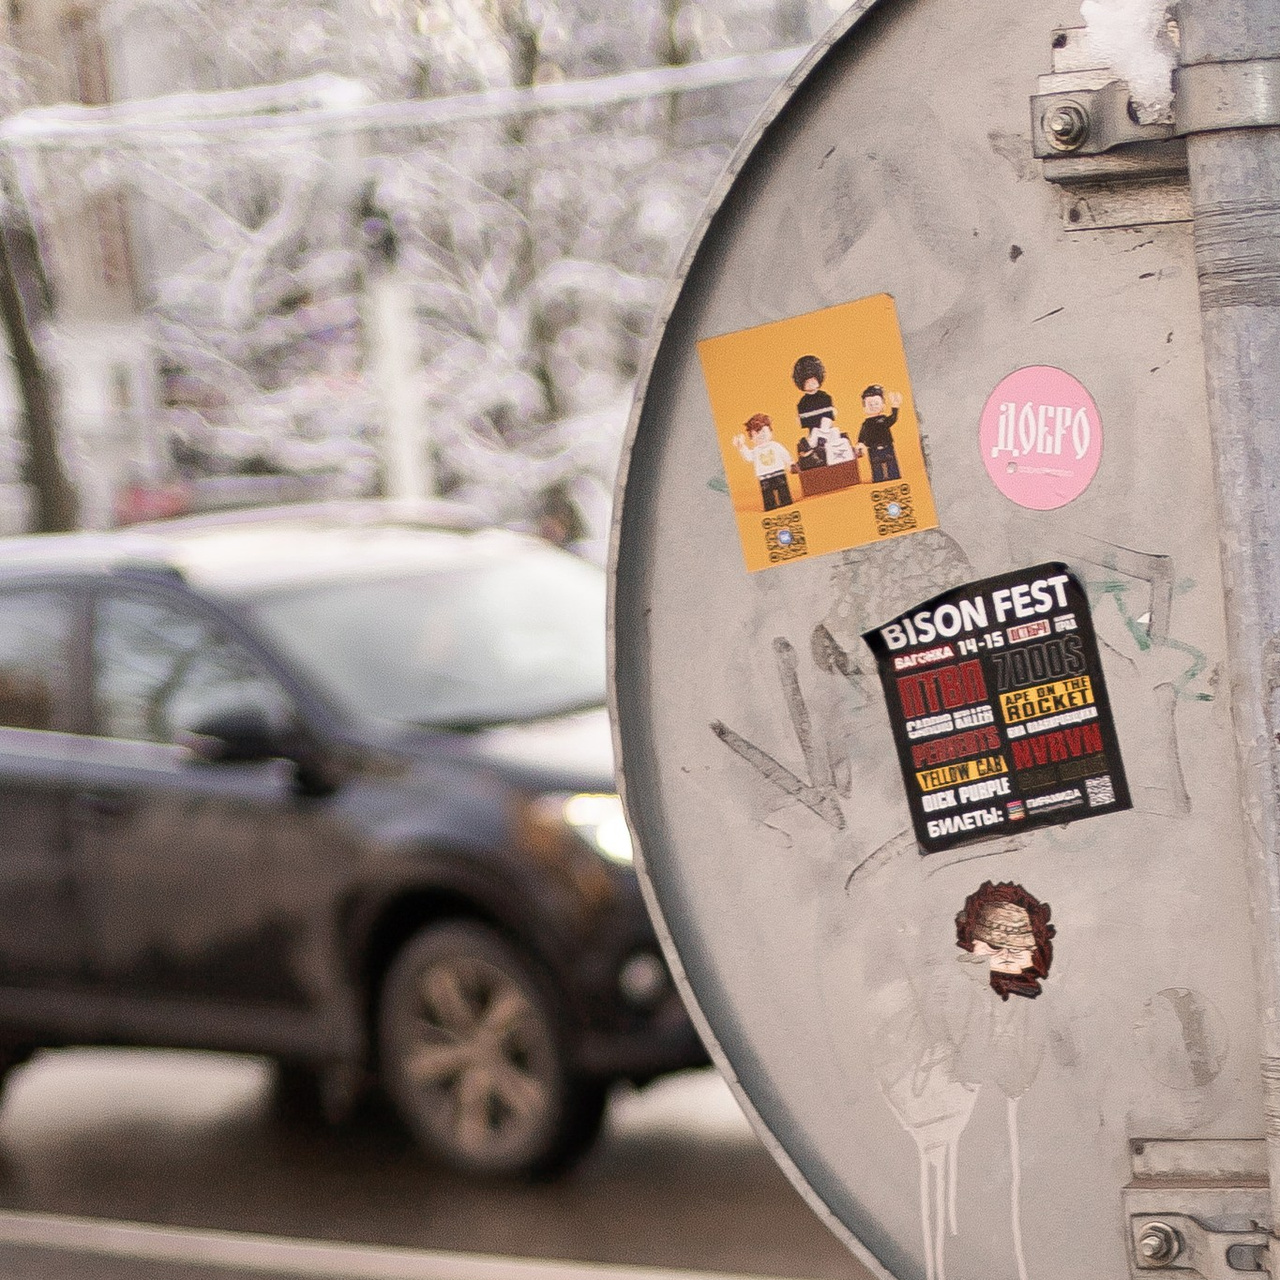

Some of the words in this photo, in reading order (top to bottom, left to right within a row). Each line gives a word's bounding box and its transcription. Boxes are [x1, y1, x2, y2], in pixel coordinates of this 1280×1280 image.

[991, 401, 1091, 459] ДОБРО
[880, 595, 988, 650] BISON
[991, 575, 1069, 622] FEST
[957, 630, 1004, 656] 14-15
[1063, 677, 1090, 695] THE
[1008, 689, 1091, 722] ROCKET
[920, 763, 970, 789] YELLOW
[959, 776, 1011, 804] PURPLE
[927, 807, 1004, 838] БИЛЕТЫ:
